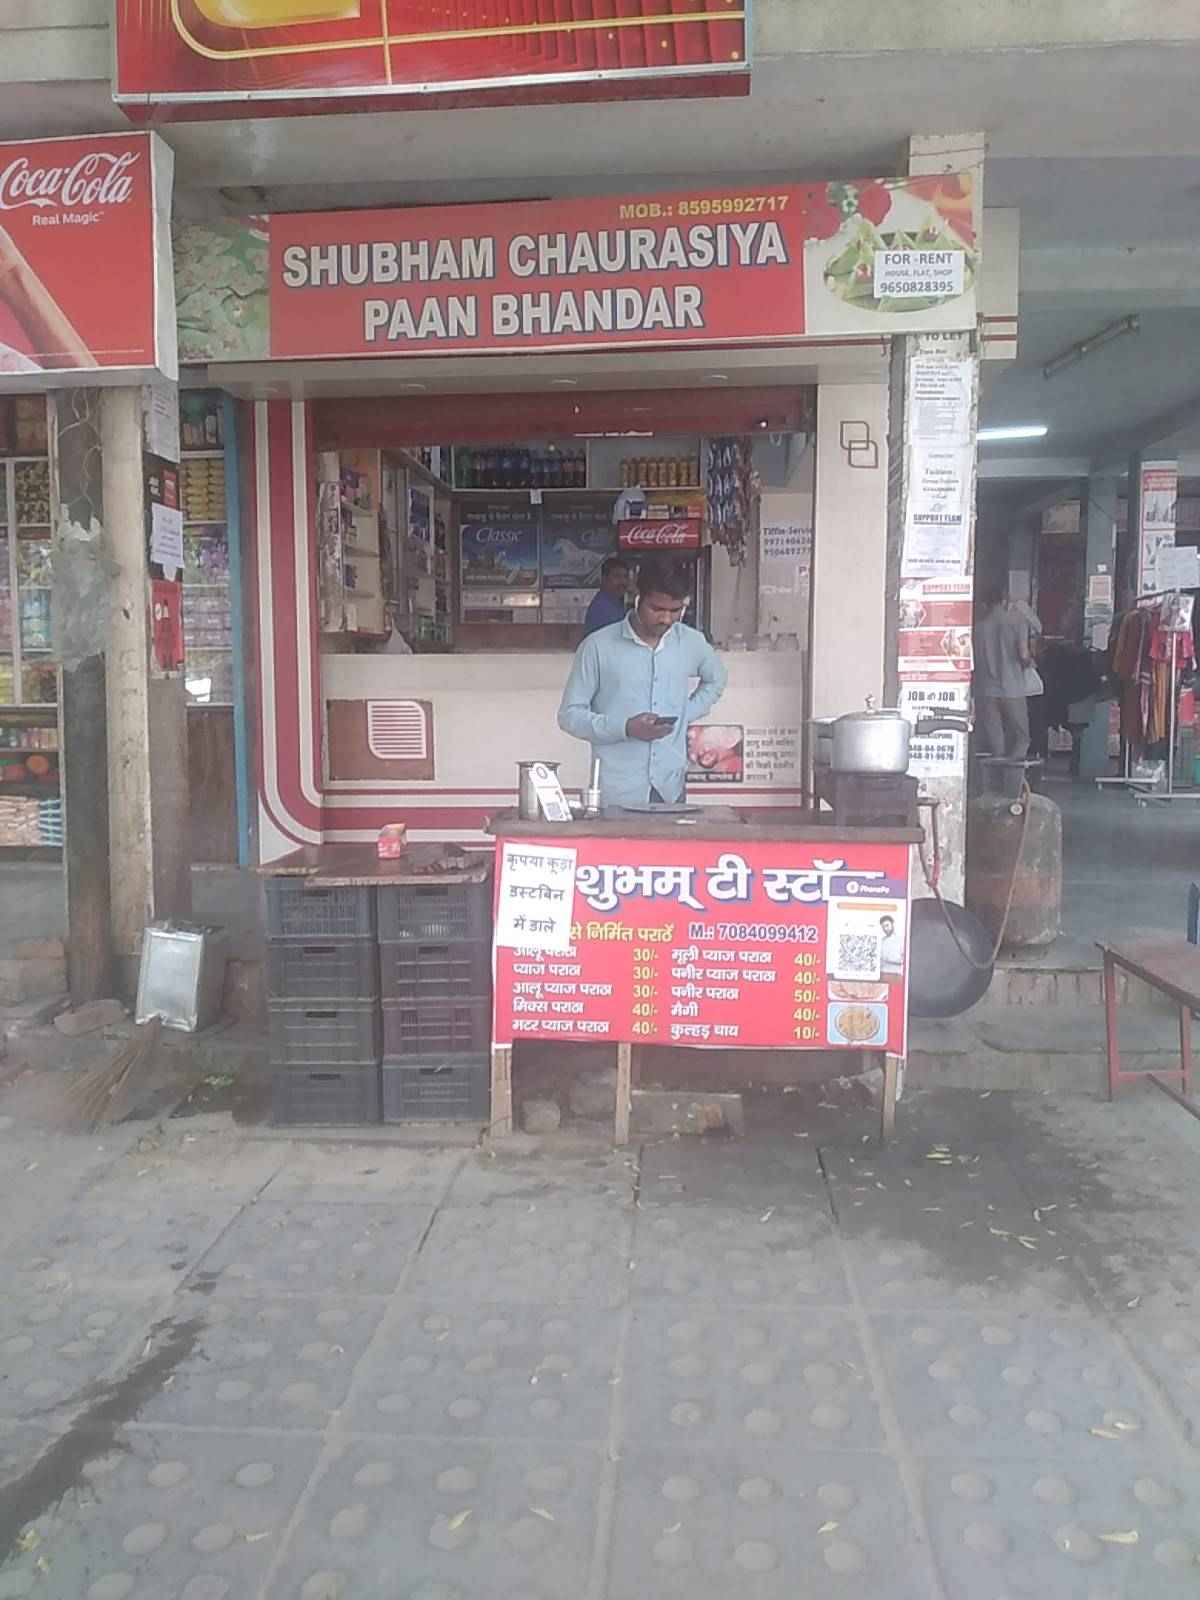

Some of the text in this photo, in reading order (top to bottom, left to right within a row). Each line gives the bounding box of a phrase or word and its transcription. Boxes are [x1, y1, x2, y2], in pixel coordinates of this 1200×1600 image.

[619, 196, 789, 219] MOB.: 8595992717
[32, 214, 60, 226] Real
[282, 221, 788, 288] SHUBHAM CHAURASIYA
[884, 253, 911, 265] FOR
[880, 281, 954, 293] 9650828395
[363, 285, 704, 341] PAAN BHANDAR
[506, 853, 544, 872] कृपया
[575, 853, 886, 912] शुभम् टी स्टॉ
[513, 913, 527, 931] में
[586, 922, 633, 942] निर्मित
[718, 925, 819, 942] 7084099412
[633, 948, 659, 961] 30/-
[703, 950, 735, 962] प्याज
[739, 951, 772, 963] पराठा
[794, 953, 821, 967] 40/-
[512, 963, 659, 980] प्याज पराठा 30/-
[671, 964, 821, 985] पनीर प्याज पराठा 40/-
[512, 982, 659, 999] आलू प्याज पराठा 30/-
[671, 983, 821, 1003] पनीर पराठा 50/-
[551, 1001, 584, 1014] पराठा
[632, 1003, 658, 1017] 40/-
[793, 1008, 820, 1022] 40/-
[541, 1020, 575, 1032] प्याज
[577, 1020, 610, 1033] पराठा
[632, 1022, 658, 1035] 40/-
[793, 1027, 820, 1040] 10/-
